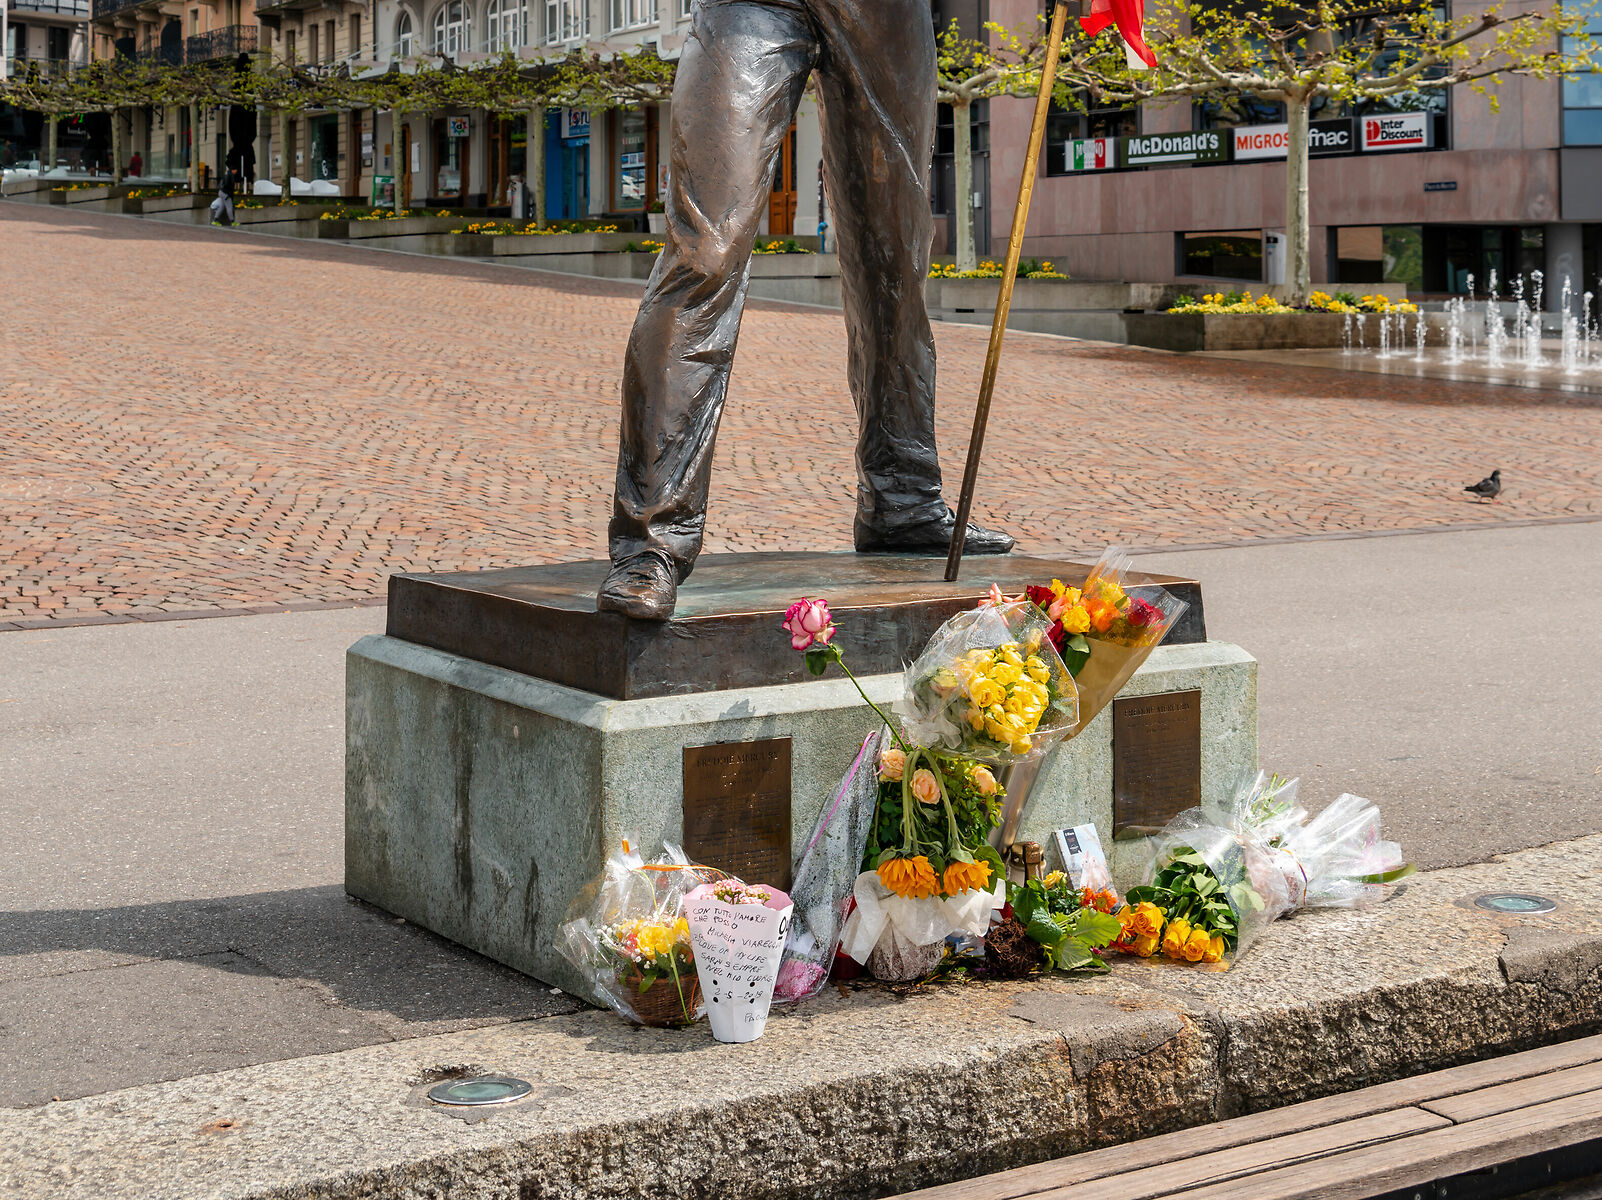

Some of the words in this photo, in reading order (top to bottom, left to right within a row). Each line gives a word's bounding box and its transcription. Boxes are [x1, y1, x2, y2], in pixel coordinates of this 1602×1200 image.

[1380, 119, 1404, 130] Inter
[1308, 128, 1349, 146] fnac
[1380, 128, 1423, 140] Discount
[1128, 133, 1219, 155] McDonald's
